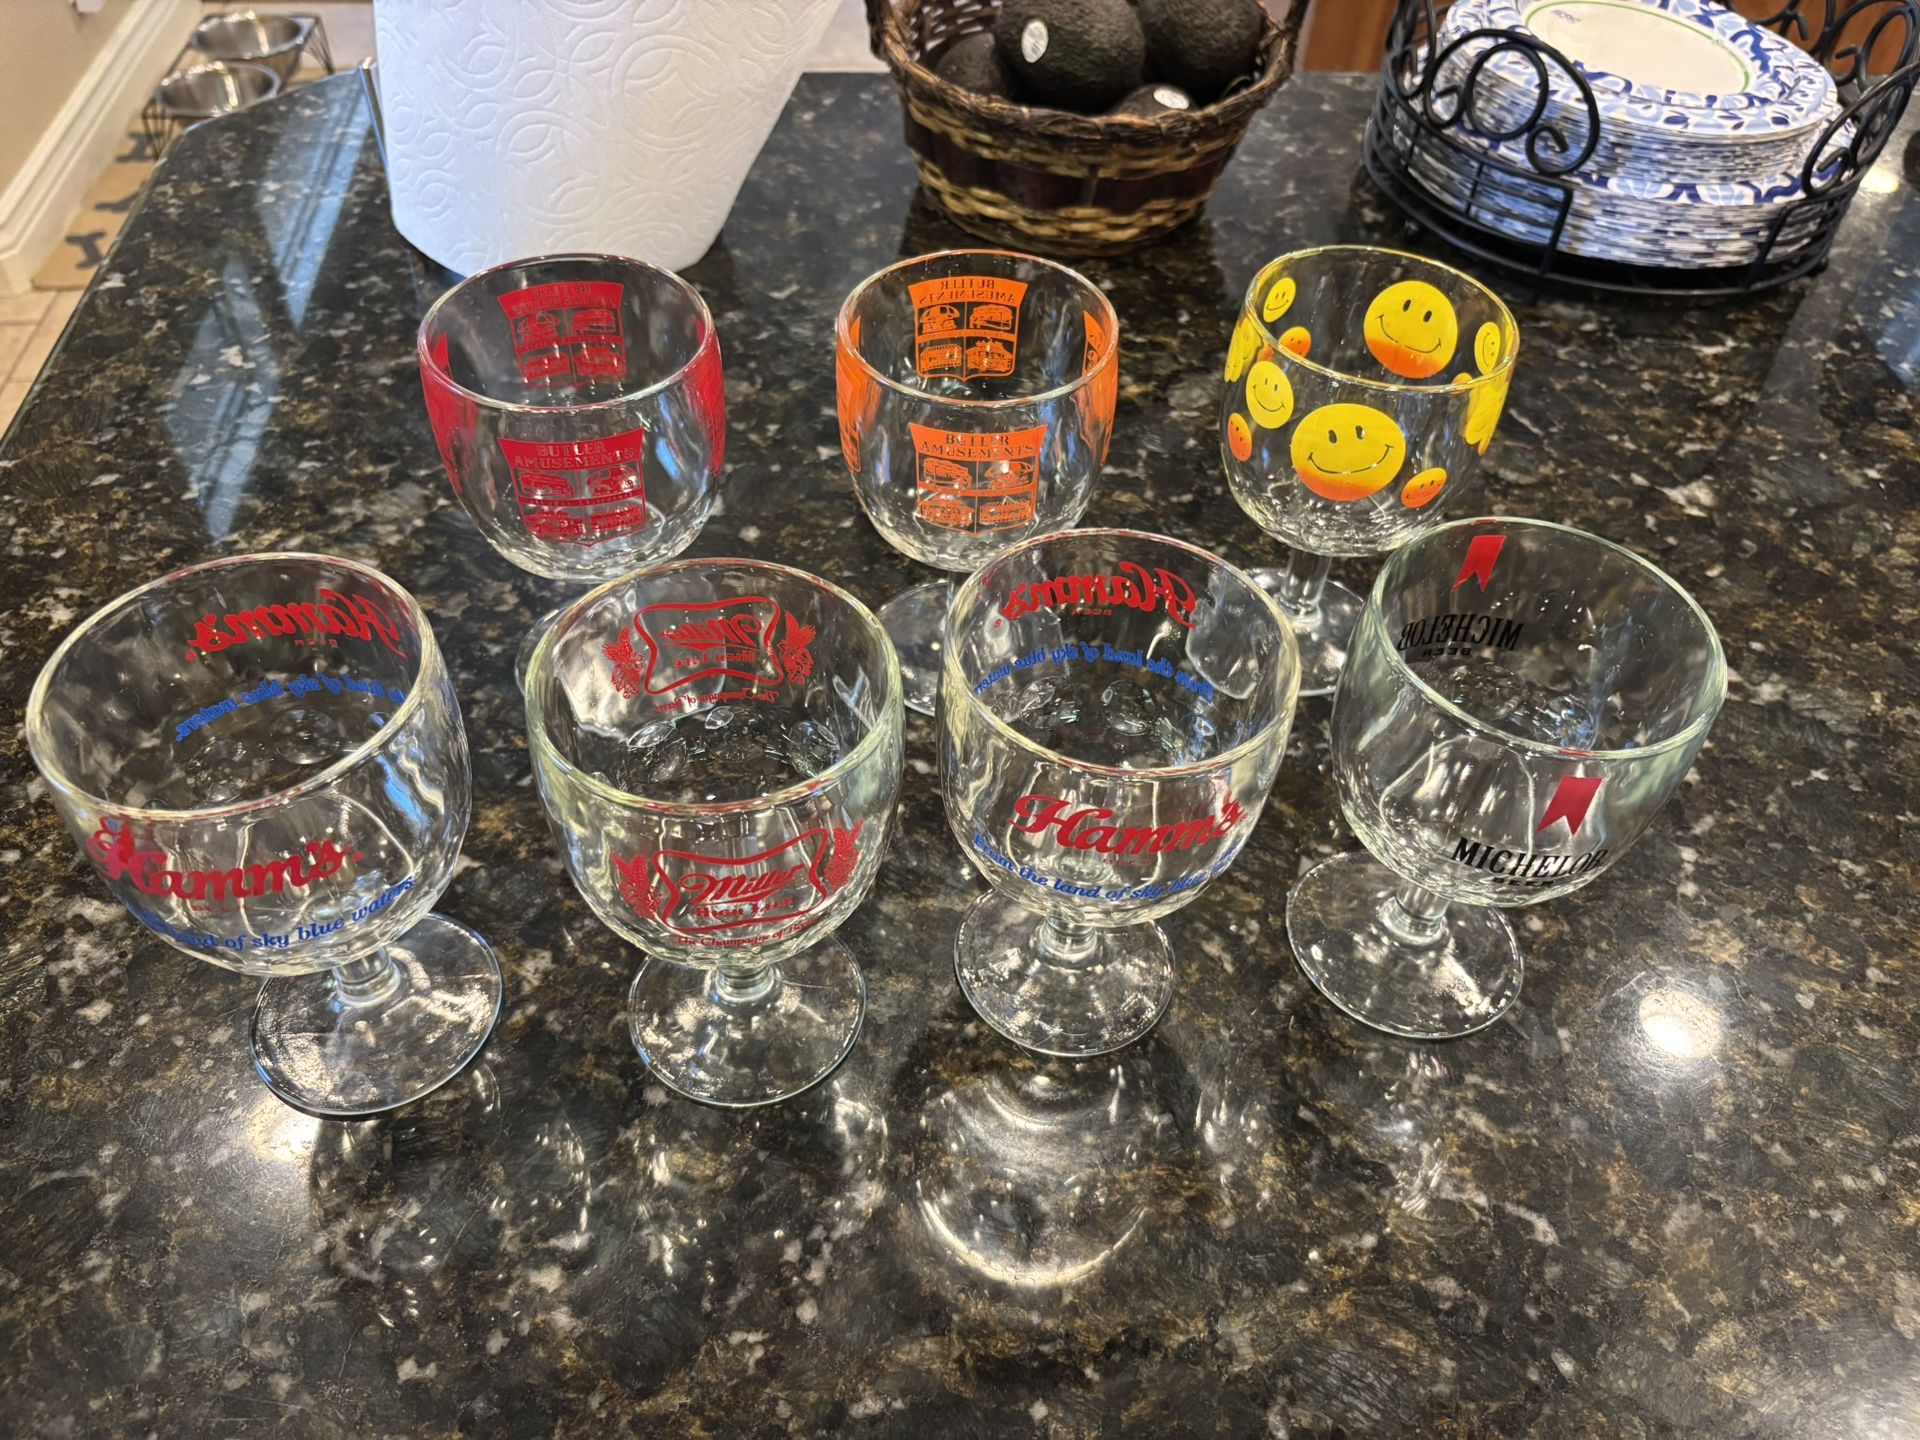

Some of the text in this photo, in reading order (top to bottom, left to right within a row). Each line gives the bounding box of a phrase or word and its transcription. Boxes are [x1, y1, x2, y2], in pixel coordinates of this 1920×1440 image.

[537, 441, 606, 457] BUTLER
[1451, 836, 1608, 877] MICHELOB
[1019, 866, 1048, 887] the
[1054, 878, 1101, 898] land
[1106, 886, 1131, 901] of
[1132, 885, 1163, 900] sky
[225, 934, 247, 950] of
[252, 933, 290, 949] sky
[297, 918, 345, 941] blue
